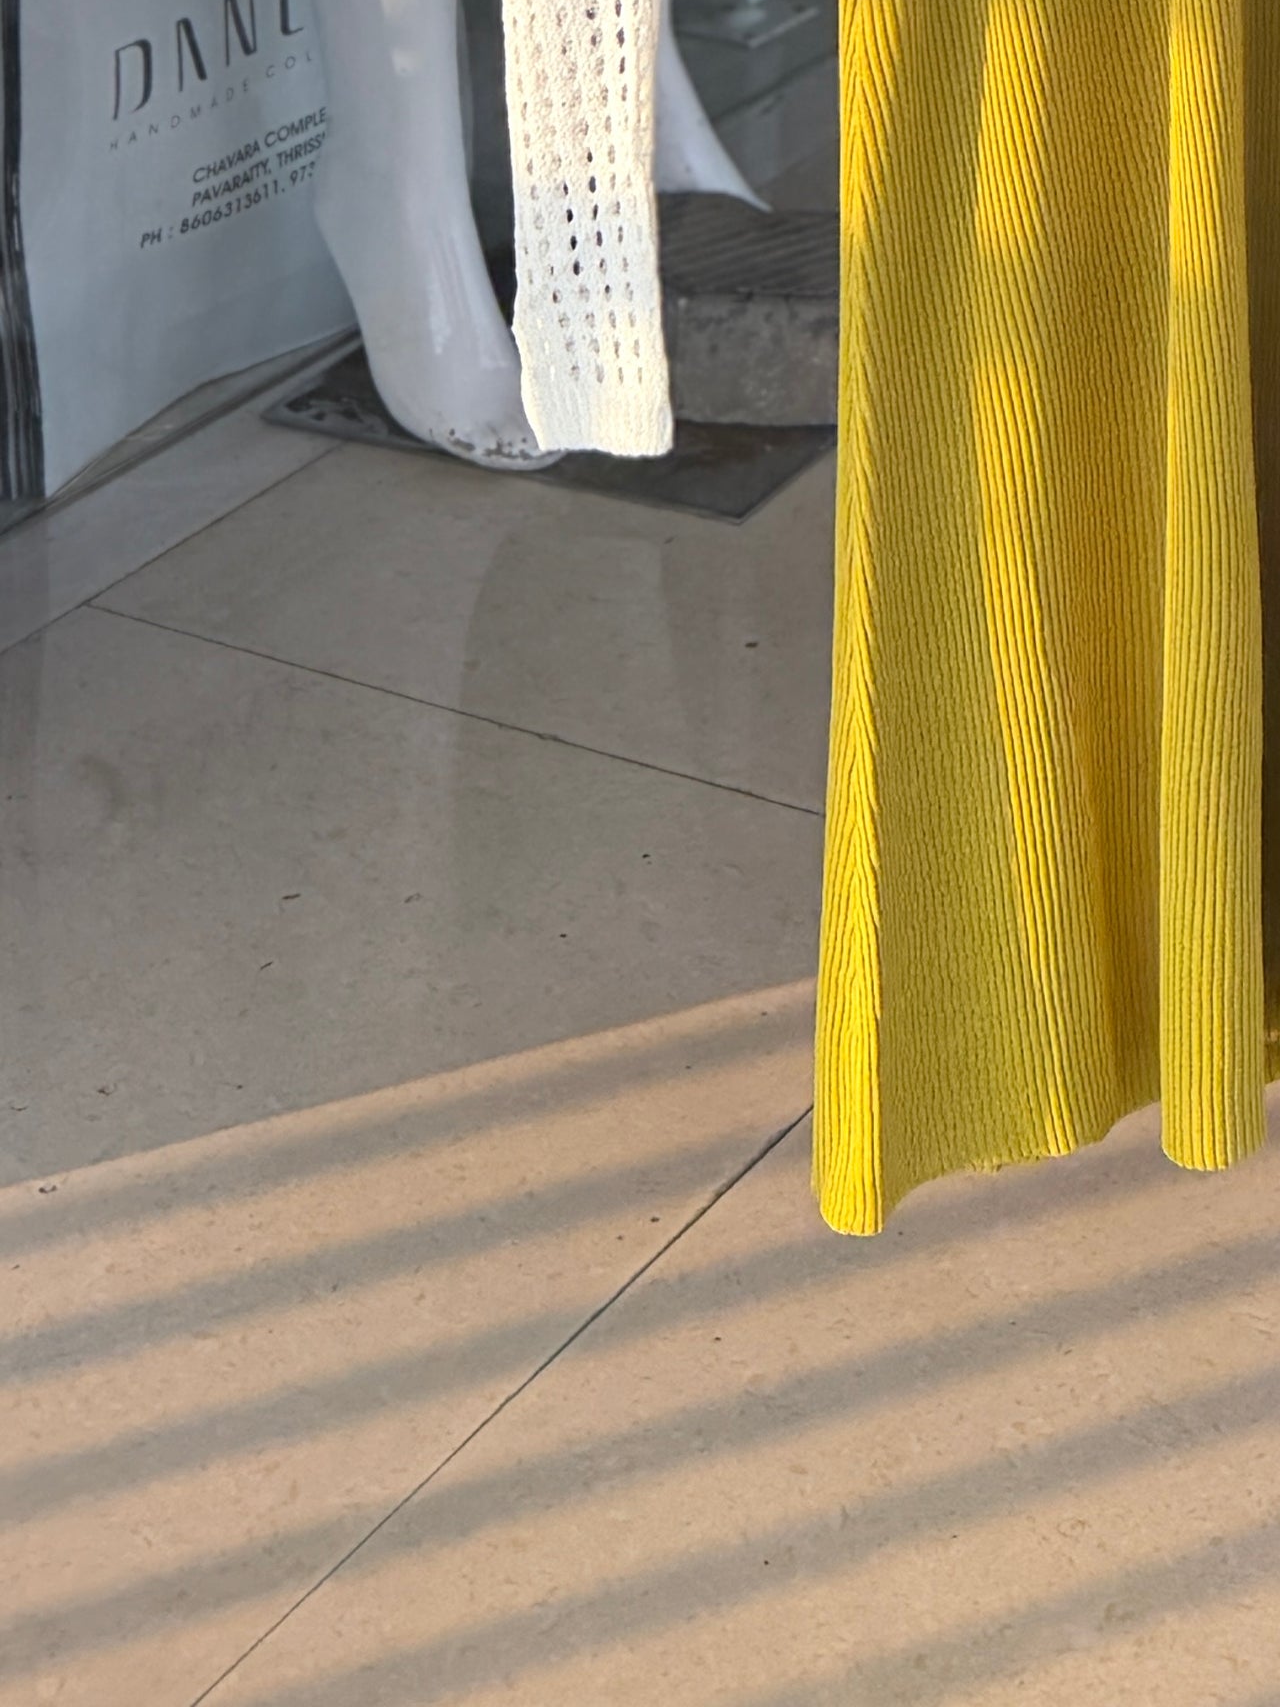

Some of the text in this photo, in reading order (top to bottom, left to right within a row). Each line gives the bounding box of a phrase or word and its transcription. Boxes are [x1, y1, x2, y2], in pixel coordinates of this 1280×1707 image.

[109, 78, 250, 150] HANDMADE
[192, 139, 260, 184] CHAVARA
[276, 130, 326, 168] THRISS
[140, 227, 163, 249] PH
